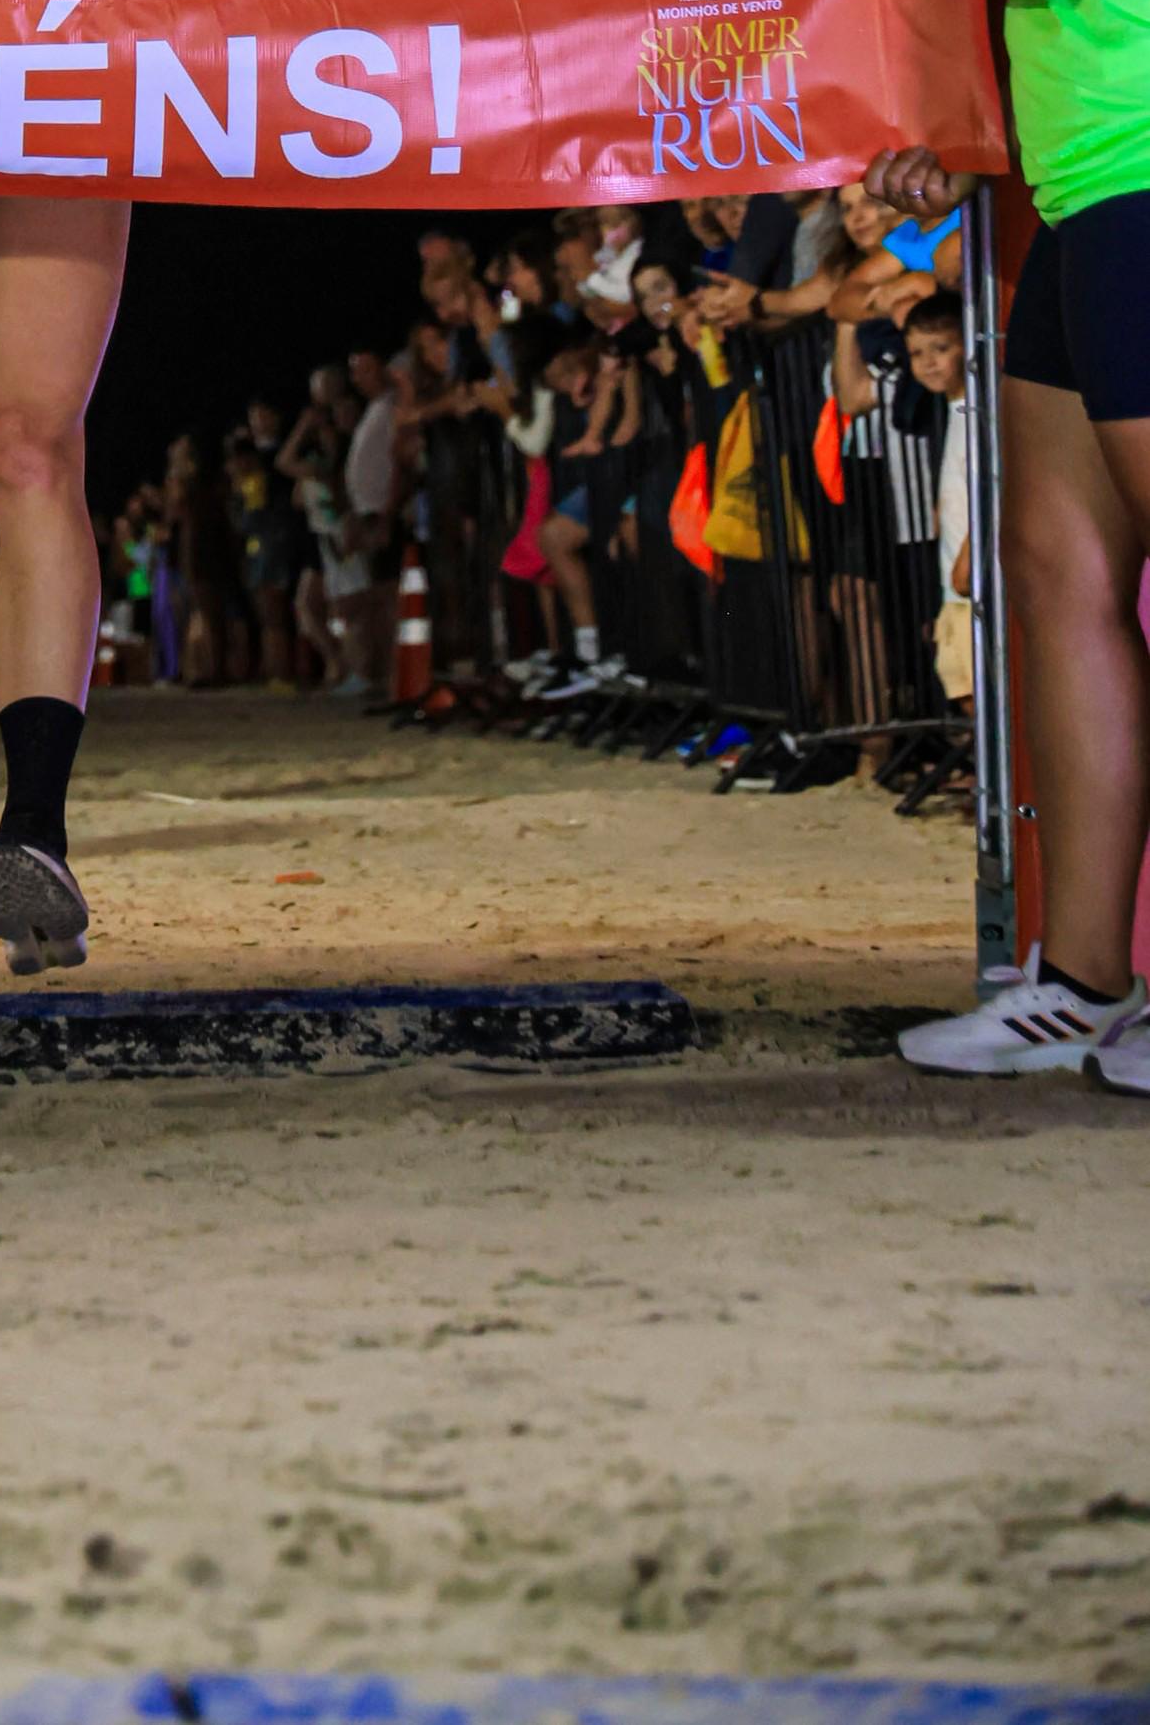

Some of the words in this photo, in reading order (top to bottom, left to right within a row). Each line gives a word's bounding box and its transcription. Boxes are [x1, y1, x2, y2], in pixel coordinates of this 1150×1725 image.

[639, 16, 804, 64] SUMMER
[657, 3, 720, 21] MOINHOS
[722, 2, 739, 16] DE
[636, 50, 809, 117] NIGHT
[651, 101, 807, 176] RUN
